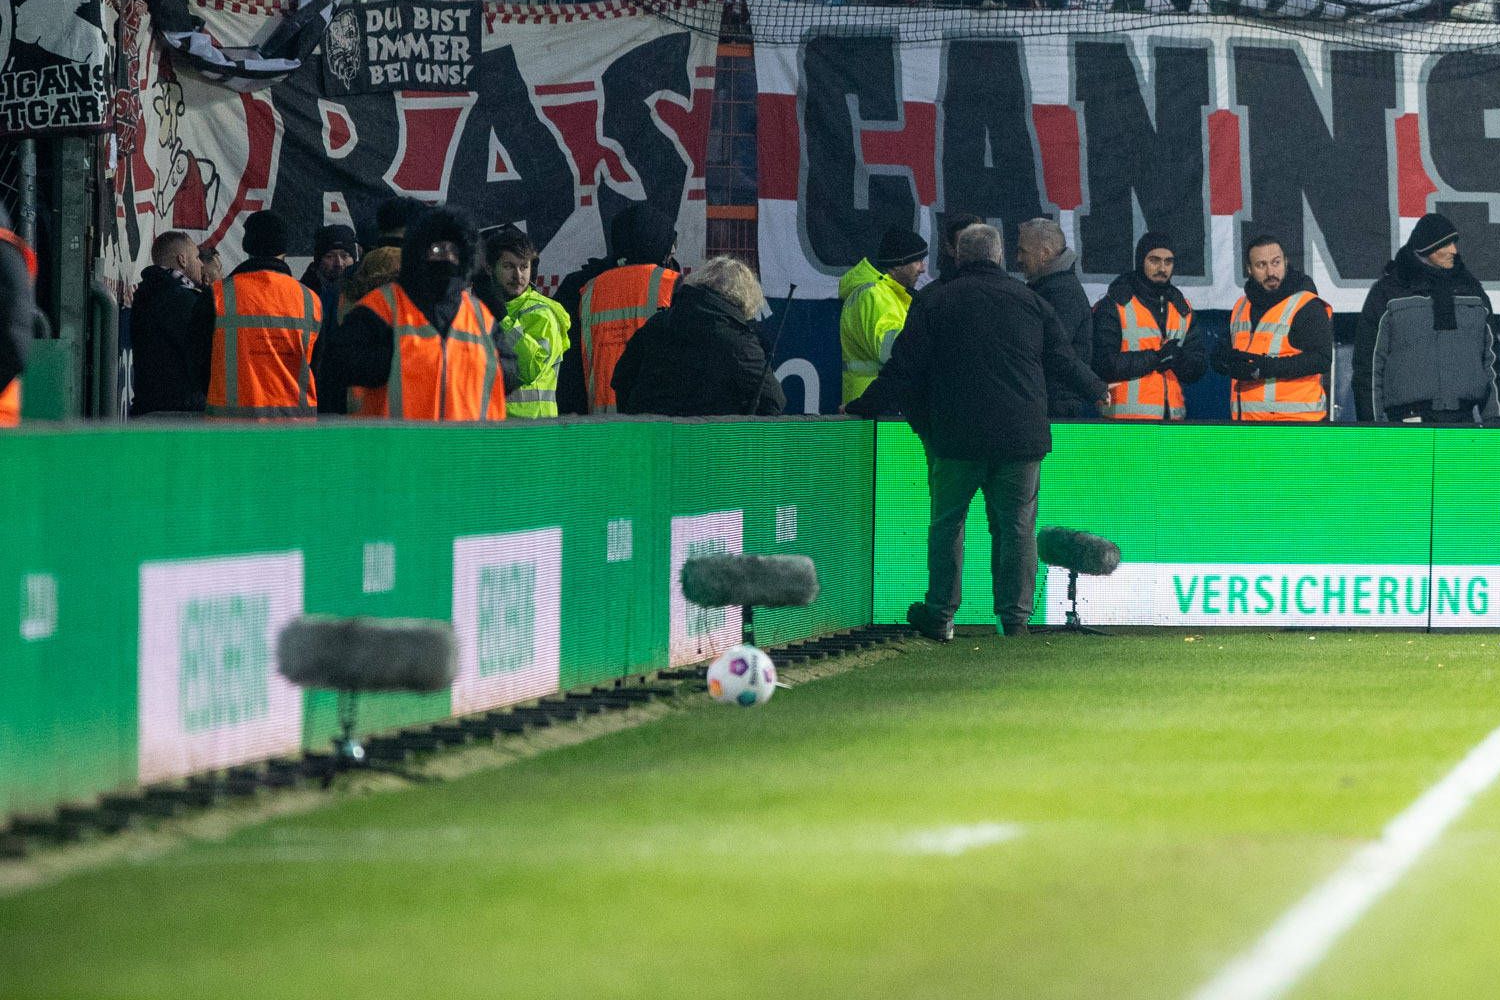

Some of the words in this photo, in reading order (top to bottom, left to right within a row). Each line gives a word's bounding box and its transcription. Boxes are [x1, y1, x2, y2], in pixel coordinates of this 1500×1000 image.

[366, 6, 402, 33] DU
[413, 6, 471, 32] BIST
[367, 32, 471, 63] IMMER
[0, 62, 104, 102] IGANS
[368, 61, 409, 85] BEI
[415, 63, 474, 85] UNS!
[0, 94, 109, 132] TGAR
[1172, 574, 1490, 615] VERSICHERUNG
